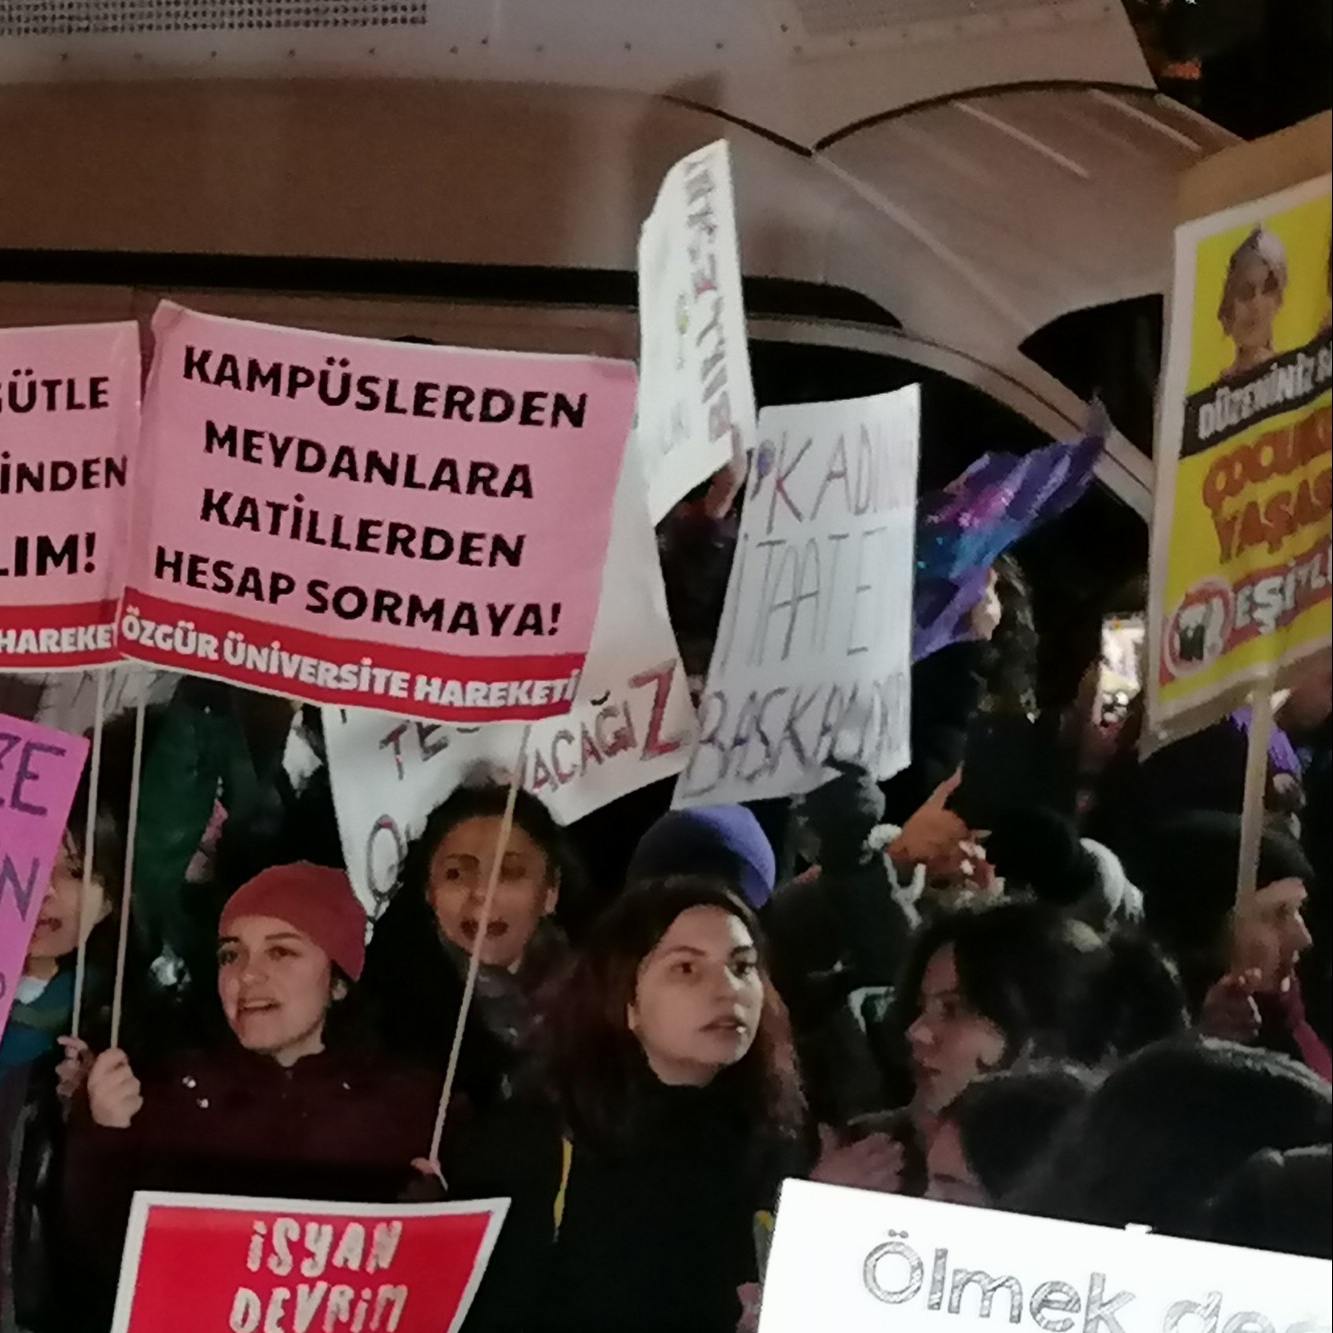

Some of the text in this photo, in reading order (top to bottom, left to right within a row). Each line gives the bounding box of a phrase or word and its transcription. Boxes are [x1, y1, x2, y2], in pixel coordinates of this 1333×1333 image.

[183, 345, 588, 429] KAMPÜSLERDEN
[204, 420, 534, 499] MEYDANLARA
[199, 488, 527, 568] KATİLLERDEN
[154, 546, 562, 638] HESAP SORMAYA!
[121, 605, 581, 709] ÖZGÜR ÜNİVERSİTE HAREKETİ
[246, 1217, 403, 1278] İSYAN
